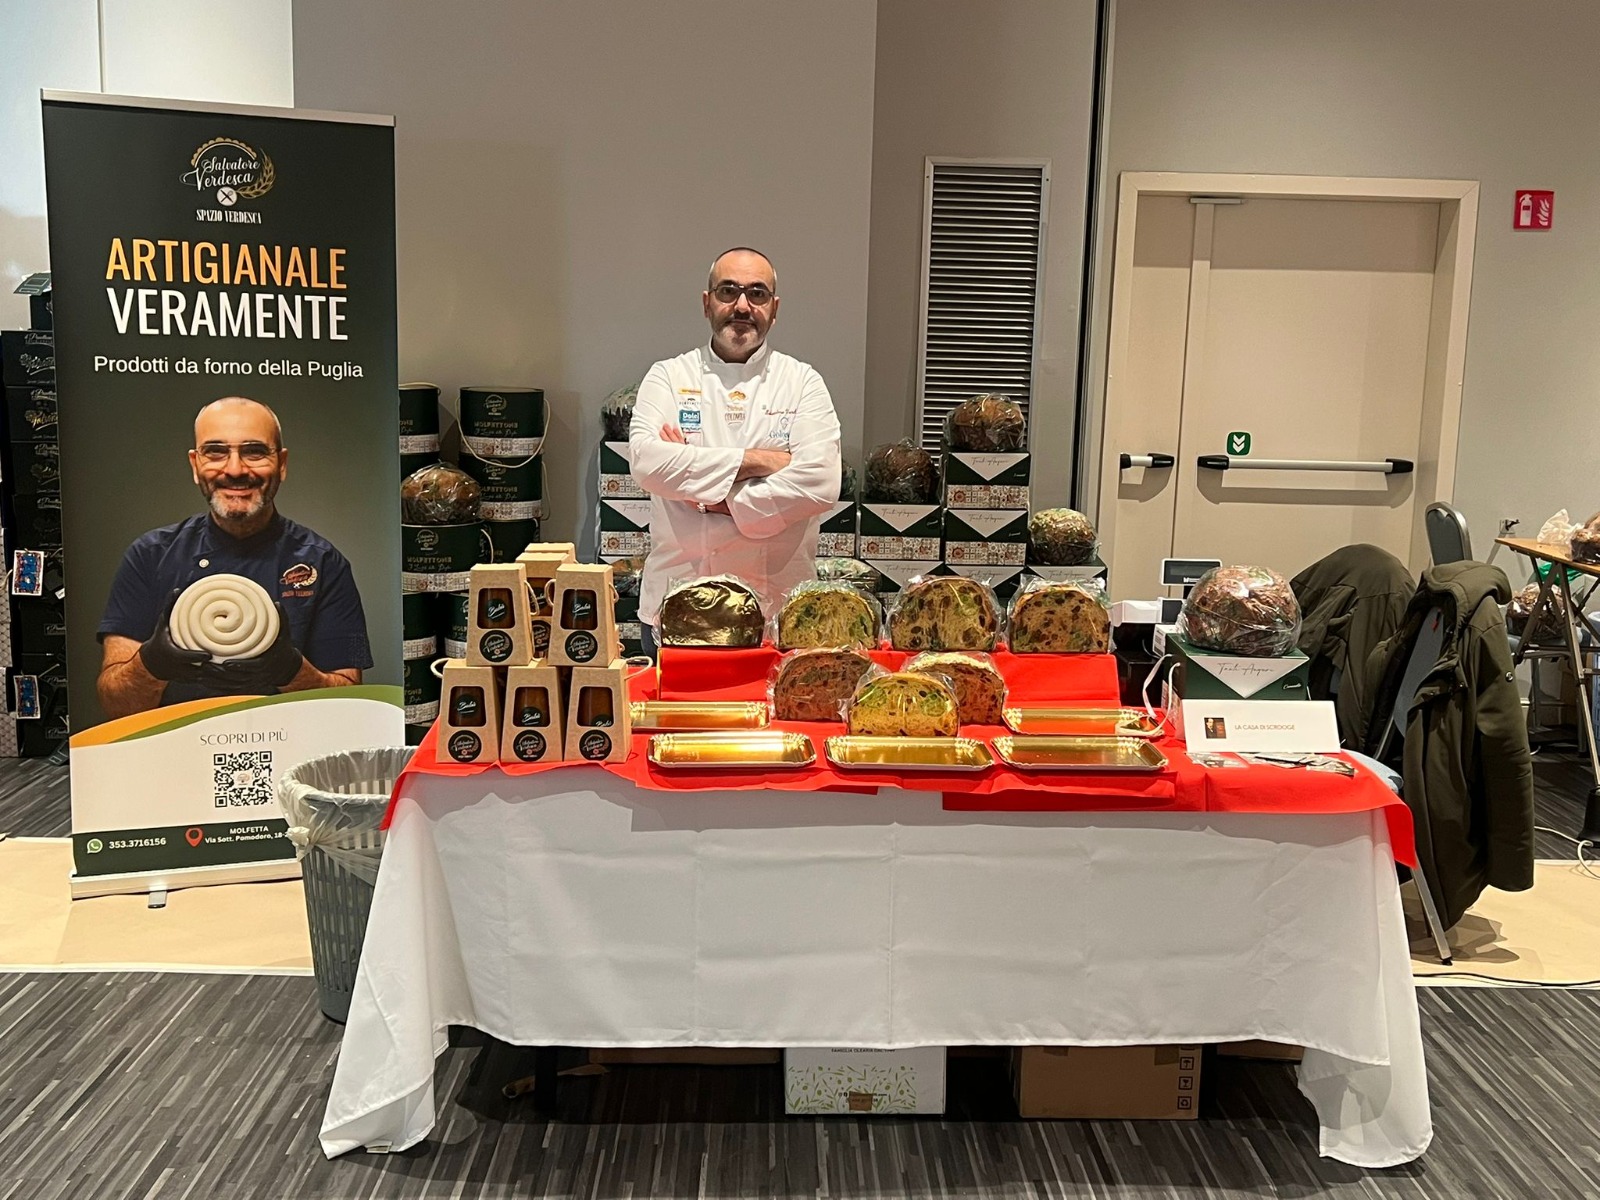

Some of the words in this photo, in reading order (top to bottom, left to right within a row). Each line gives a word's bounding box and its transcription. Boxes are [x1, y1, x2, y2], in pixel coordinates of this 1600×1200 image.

[201, 156, 260, 173] Salvatore
[179, 167, 254, 191] Verdesca
[196, 209, 223, 222] SPAZIO
[224, 210, 262, 224] VERDESCA
[105, 237, 347, 289] ARTIGIANALE
[106, 287, 348, 340] VERAMENTE
[94, 355, 169, 373] Prodotti
[175, 357, 198, 374] da
[204, 358, 252, 375] forno
[258, 359, 302, 376] della
[307, 361, 363, 381] Puglia
[200, 733, 248, 746] SCOPRI
[251, 732, 266, 744] DI
[268, 727, 288, 743] PIÙ
[229, 826, 269, 834] MOLFETTA
[236, 833, 273, 841] Pomodoro,
[109, 837, 167, 849] 353.3716156
